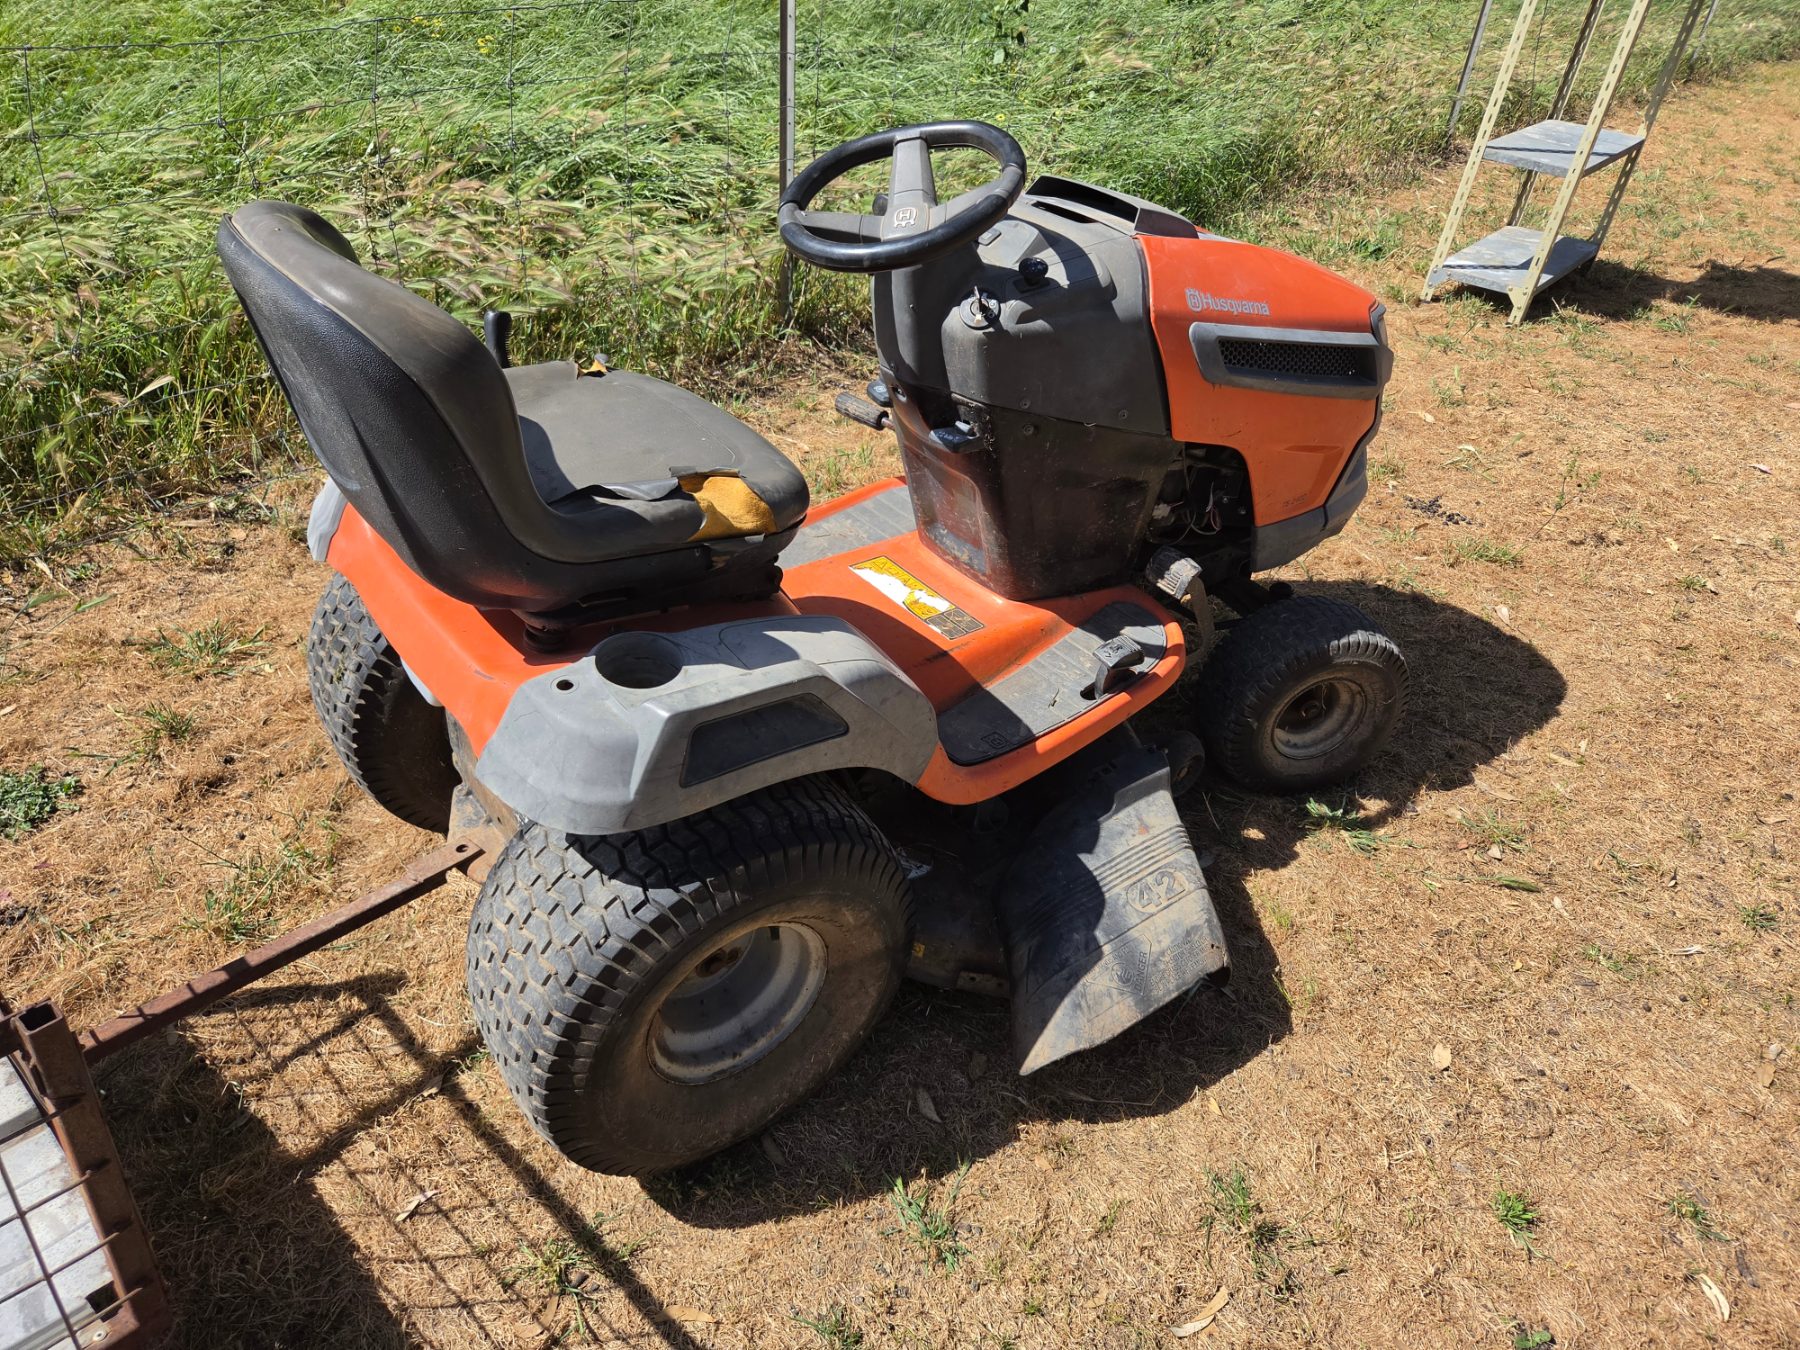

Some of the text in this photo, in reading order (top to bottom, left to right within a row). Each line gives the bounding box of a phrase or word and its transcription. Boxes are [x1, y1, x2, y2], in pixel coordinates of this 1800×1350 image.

[1201, 293, 1270, 316] Husqvarna
[1139, 870, 1186, 909] 42
[1134, 951, 1147, 992] DANGER
